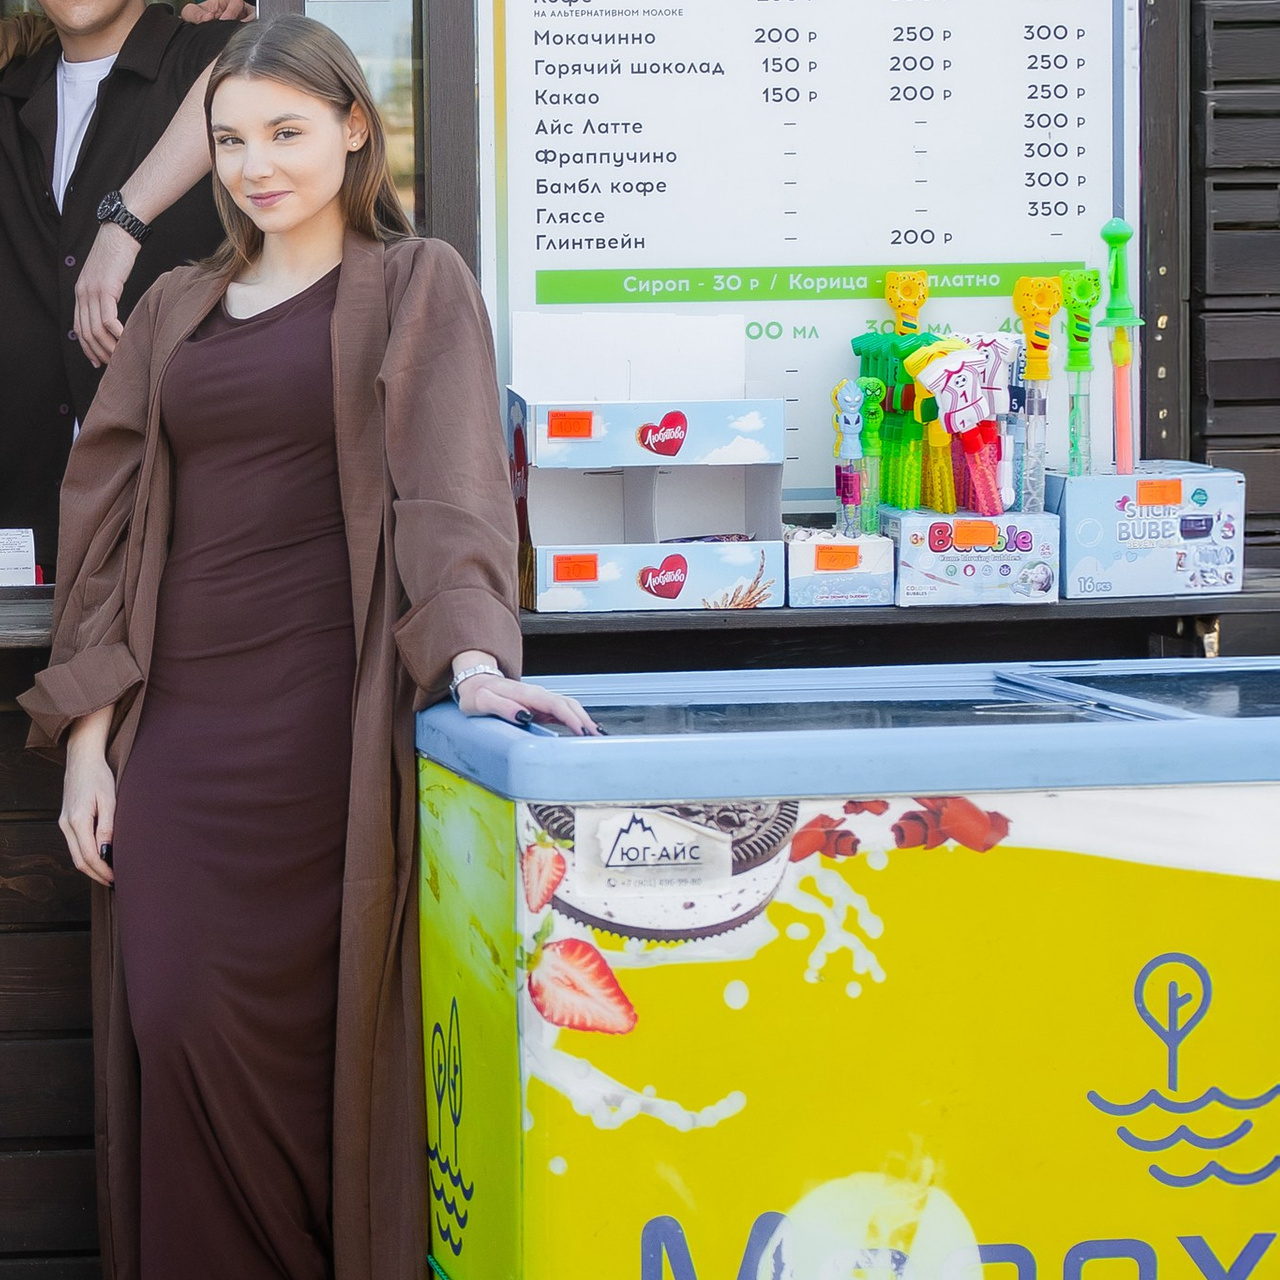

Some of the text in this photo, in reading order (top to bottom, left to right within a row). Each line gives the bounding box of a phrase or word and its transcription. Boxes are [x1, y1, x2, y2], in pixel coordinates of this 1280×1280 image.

[551, 8, 640, 18] АЛЬТЕРНАТИВНОМ
[642, 8, 684, 17] МОЛОКЕ
[534, 30, 656, 46] Мокачинно
[755, 28, 800, 44] 200
[893, 27, 935, 42] 250
[1024, 25, 1068, 41] 300
[535, 58, 621, 80] Горячий
[630, 62, 725, 76] шоколад
[762, 57, 800, 73] 150
[890, 56, 935, 72] 200
[1027, 55, 1069, 70] 250
[535, 90, 600, 106] Какао
[762, 87, 800, 103] 150
[890, 86, 935, 102] 200
[1027, 84, 1069, 100] 250
[535, 119, 574, 135] Айс
[582, 119, 643, 135] Латте
[1024, 113, 1069, 129] 300
[535, 149, 678, 169] Фраппучино
[1024, 143, 1069, 159] 300
[536, 178, 602, 195] Бамбл
[610, 181, 667, 197] кофе
[1024, 172, 1069, 188] 300
[536, 209, 605, 225] Гляссе
[1028, 201, 1069, 217] 350
[536, 234, 645, 251] Глинтвейн
[891, 229, 936, 245] 200
[623, 275, 690, 296] Сироп
[713, 275, 742, 291] 30
[789, 273, 868, 293] Корица
[927, 272, 1000, 287] платно
[745, 321, 784, 340] 00
[960, 390, 969, 403] 1
[1011, 397, 1018, 410] 5
[644, 427, 685, 452] Любятово
[911, 533, 925, 545] 3+
[929, 522, 1033, 553] Bble
[644, 568, 685, 594] Любятово
[1078, 577, 1112, 592] 16 PCS
[620, 842, 700, 862] ЮГ-АЙС
